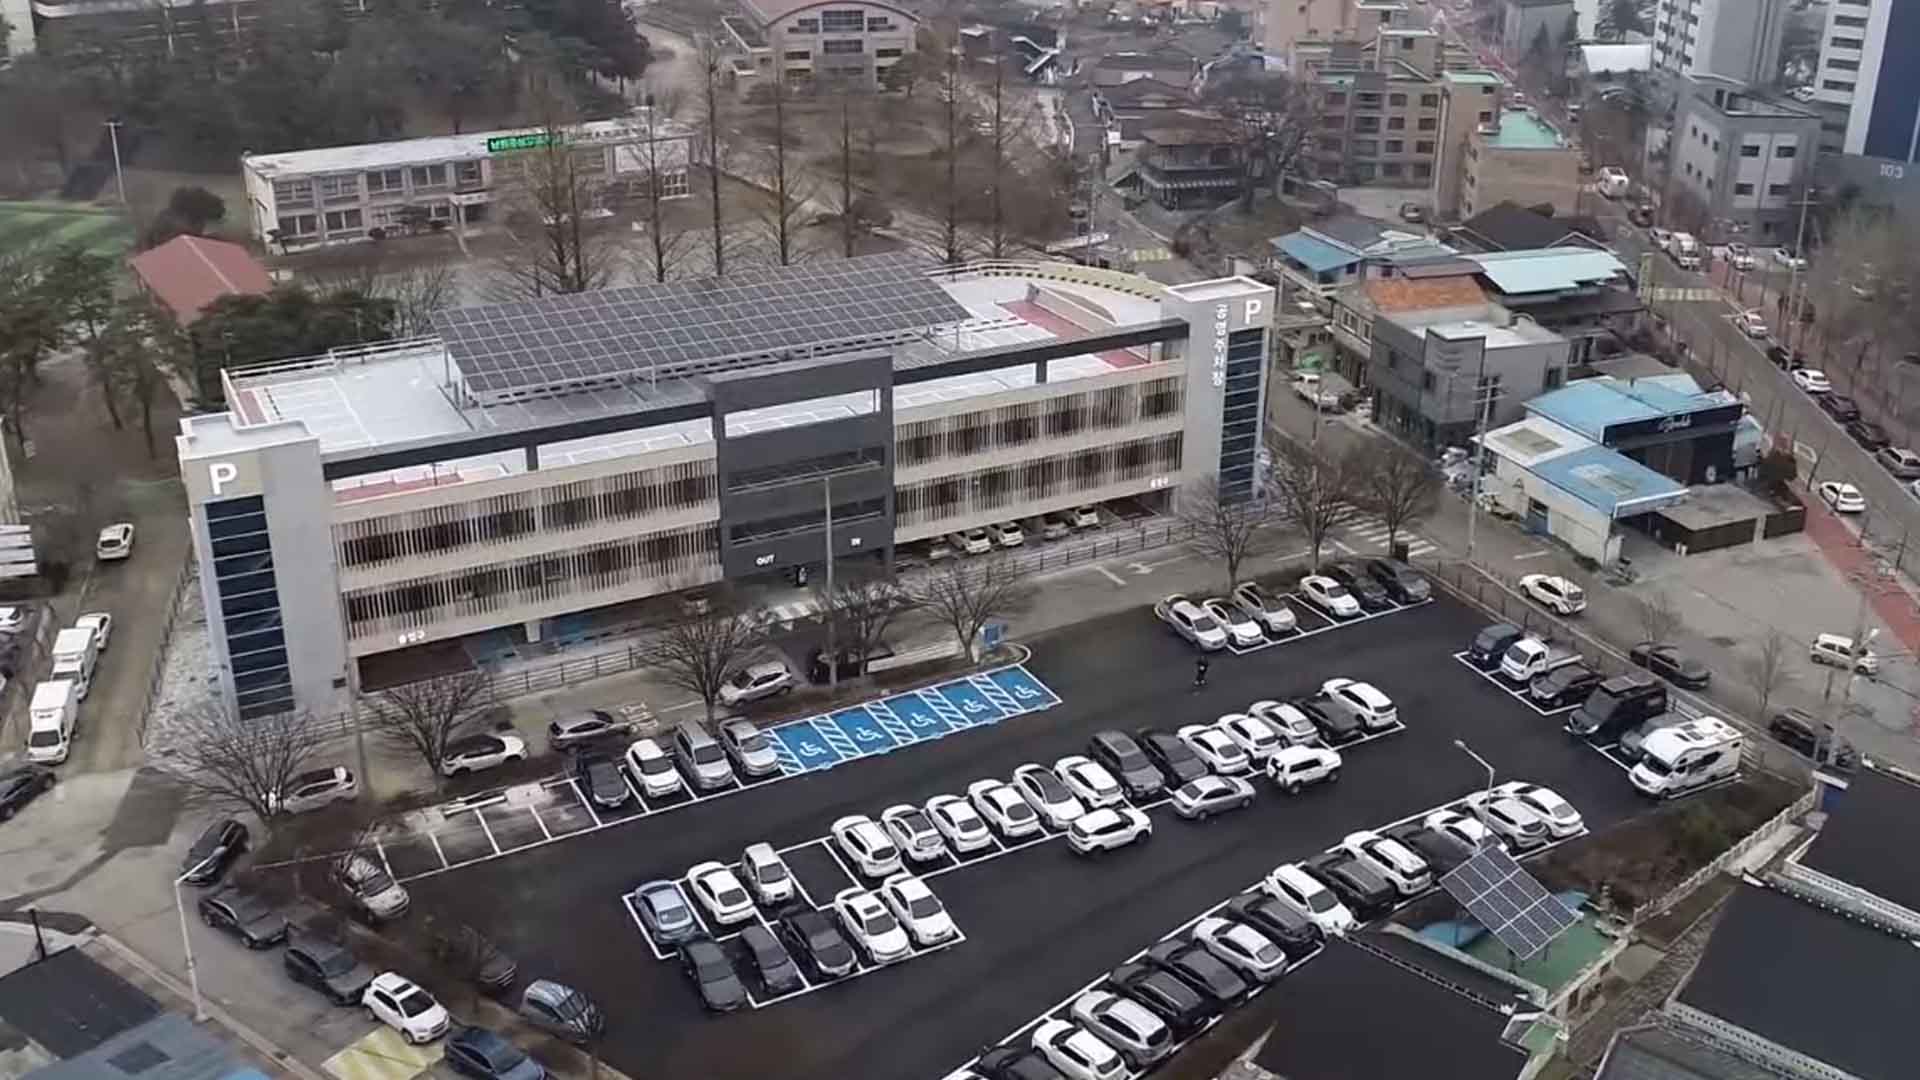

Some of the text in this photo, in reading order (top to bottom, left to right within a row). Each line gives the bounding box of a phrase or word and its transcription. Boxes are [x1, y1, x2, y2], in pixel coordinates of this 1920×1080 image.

[1245, 300, 1261, 325] P
[210, 463, 237, 495] P
[756, 554, 775, 565] OUT
